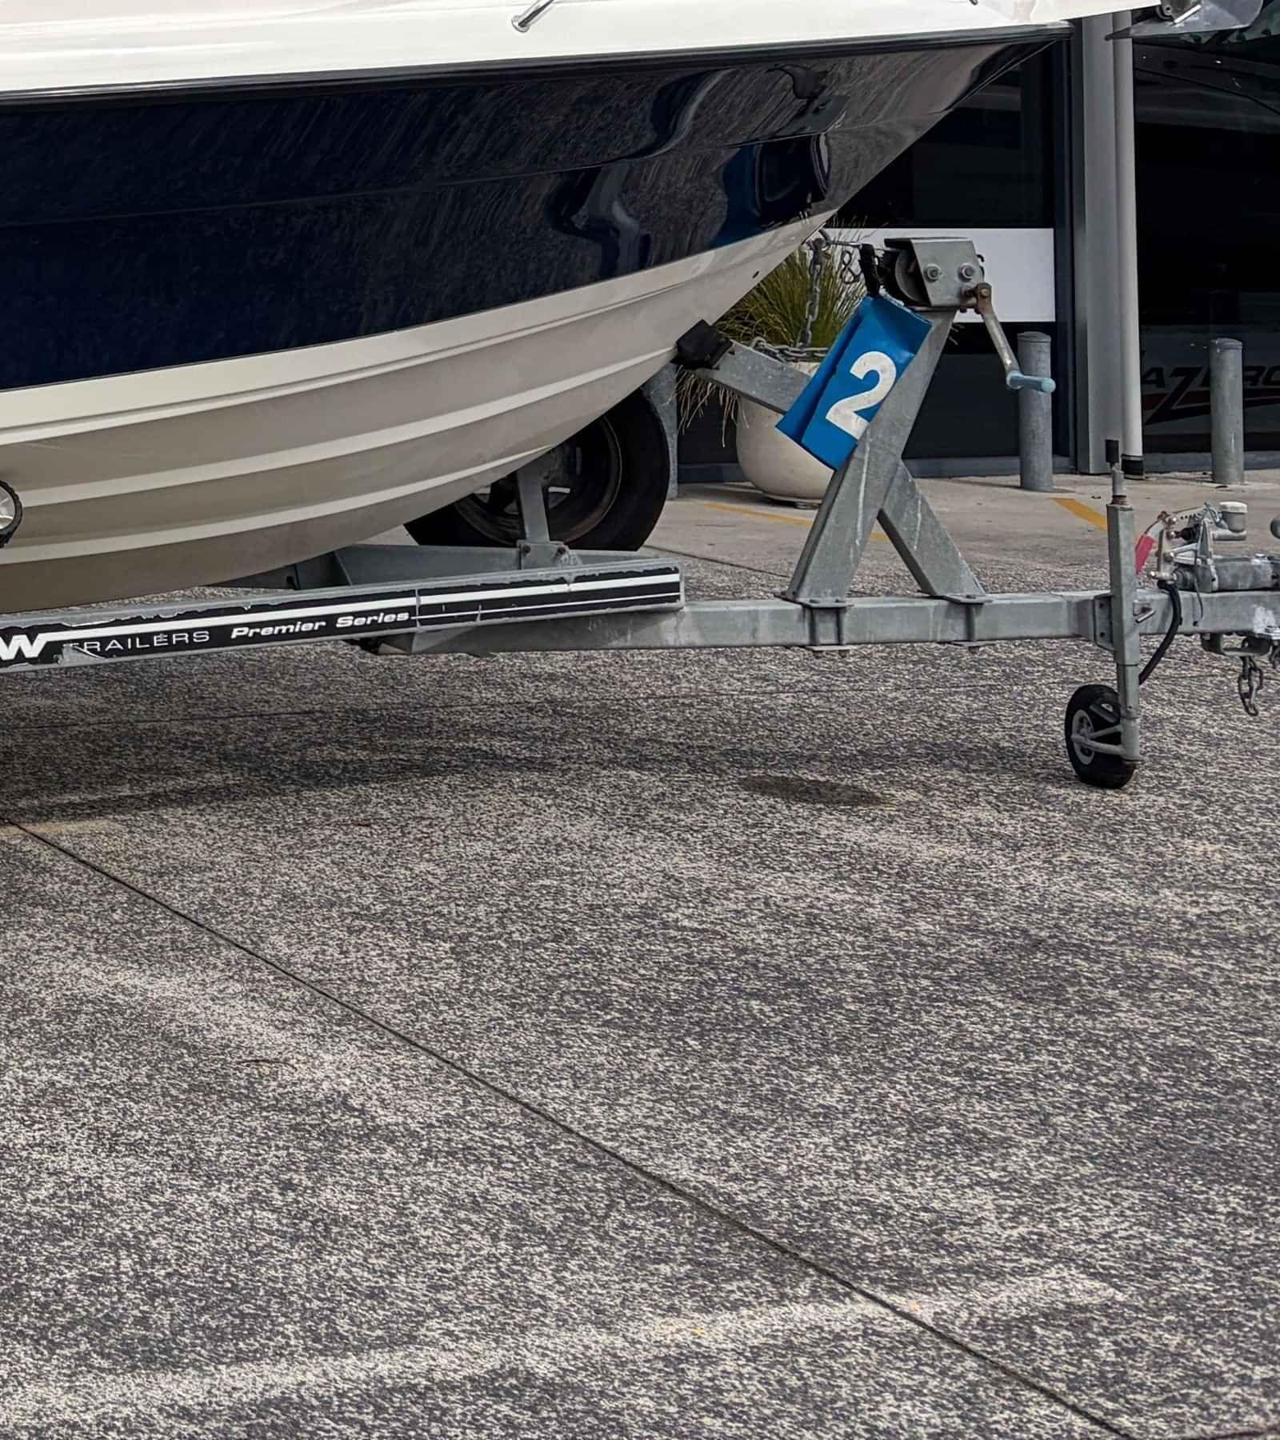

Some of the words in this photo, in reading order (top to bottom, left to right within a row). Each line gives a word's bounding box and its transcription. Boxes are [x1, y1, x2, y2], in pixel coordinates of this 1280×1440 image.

[825, 351, 896, 441] 2
[230, 620, 327, 639] Premier
[336, 612, 410, 628] Series
